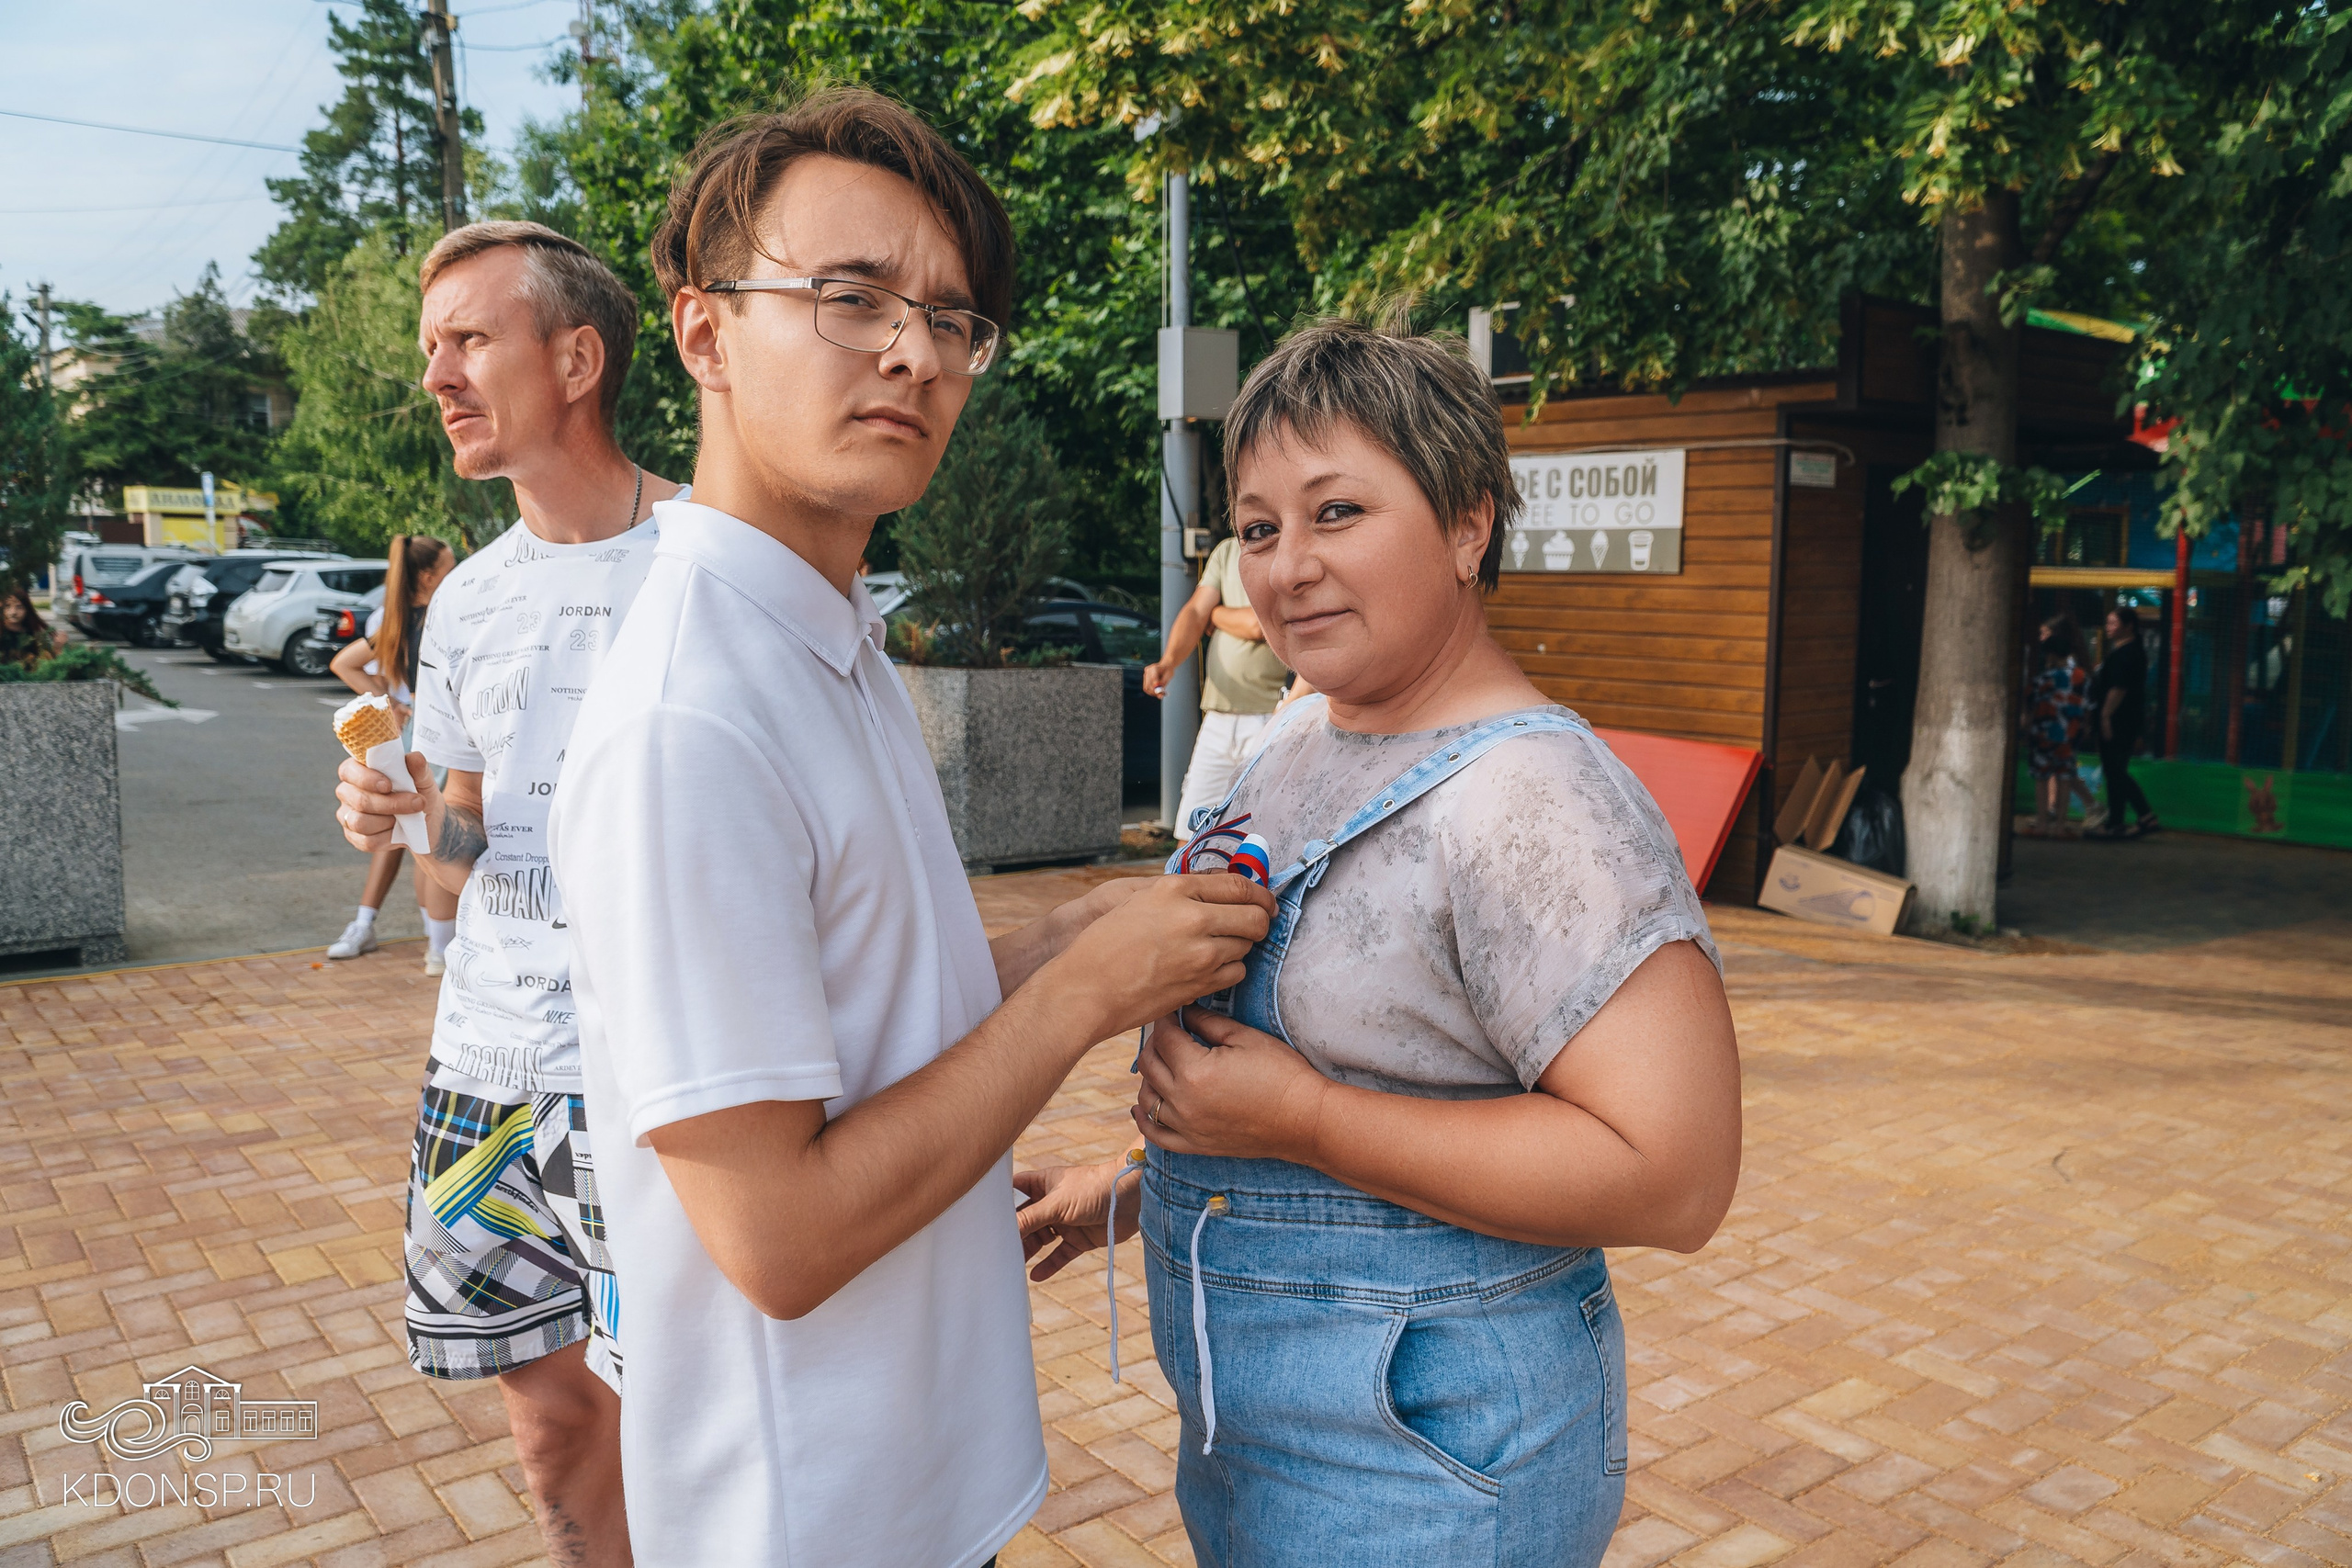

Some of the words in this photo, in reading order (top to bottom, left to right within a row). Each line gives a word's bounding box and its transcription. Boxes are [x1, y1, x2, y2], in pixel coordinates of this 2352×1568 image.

[1547, 468, 1561, 499] С
[1569, 457, 1657, 499] СОБОЙ
[1569, 502, 1600, 525] TO
[1614, 501, 1655, 525] GO
[595, 548, 629, 563] NIKE
[461, 578, 476, 588] AIR
[559, 606, 612, 617] JORDAN
[517, 611, 542, 635] 23
[570, 629, 600, 651] 23
[471, 653, 502, 663] NOTHING
[494, 852, 524, 862] Constant
[542, 1010, 576, 1025] NIKE
[448, 1043, 546, 1092] JORDAN
